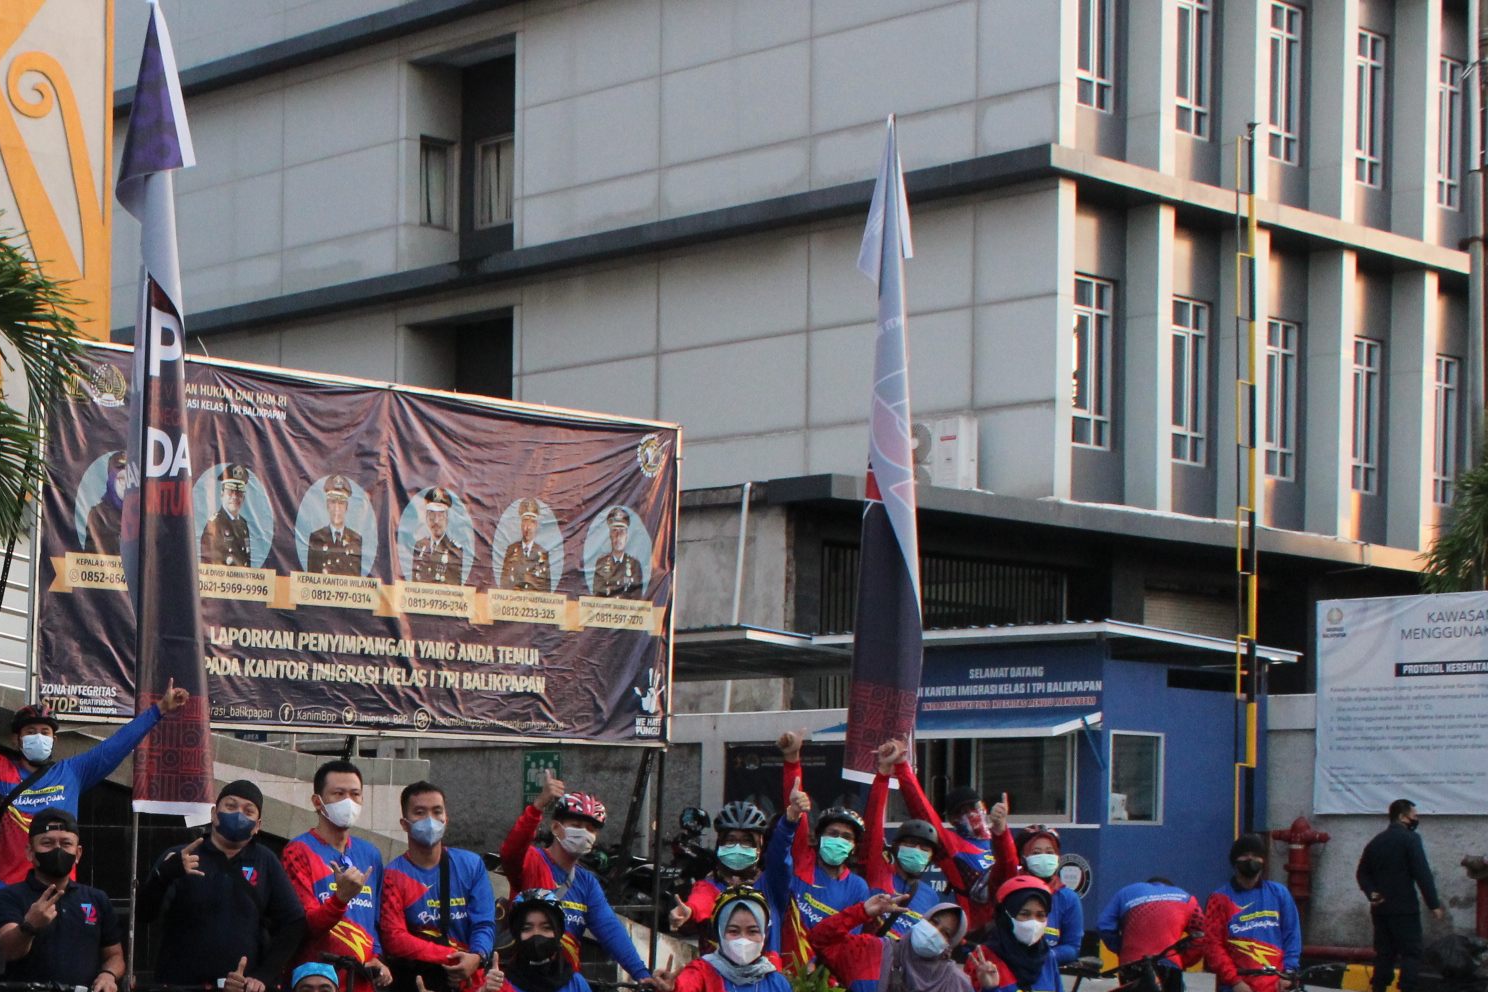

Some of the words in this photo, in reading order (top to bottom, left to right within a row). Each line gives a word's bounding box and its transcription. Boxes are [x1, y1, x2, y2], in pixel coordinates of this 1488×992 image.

[200, 384, 234, 400] HUKUM
[235, 389, 254, 402] DAN
[256, 392, 276, 406] HAM
[278, 395, 287, 407] RI
[186, 398, 200, 409] ASI
[201, 399, 224, 413] KELAS
[243, 406, 287, 421] BALIKPAPAN
[76, 558, 100, 567] KEPALA
[226, 571, 266, 581] ADMINISTRASI
[297, 575, 321, 584] KEPALA
[322, 577, 349, 587] KANTOR
[349, 579, 378, 589] WILAYAH
[311, 588, 371, 604] 0812-797-0314
[408, 597, 469, 612] 0813-9736-3346
[501, 605, 556, 620] 0812-2233-325
[1426, 609, 1488, 623] KAWASA
[210, 626, 295, 650] LAPORKAN
[297, 631, 415, 658] PENYIMPANGAN
[418, 640, 456, 661] YANG
[457, 643, 495, 663] ANDA
[497, 646, 540, 666] TEMUI
[244, 658, 309, 681] KANTOR
[312, 662, 380, 685] IMIGRASI
[383, 667, 428, 688] KELAS
[430, 670, 435, 687] I
[437, 670, 460, 689] TPI
[462, 672, 546, 694] BALIKPAPAN
[969, 667, 1009, 680] SELAMAT
[1403, 663, 1445, 675] PROTOKOL
[1446, 662, 1488, 673] KESEHATA
[41, 684, 67, 695] ZONA
[67, 684, 117, 697] INTEGRITAS
[924, 686, 957, 698] KANTOR
[958, 684, 998, 697] IMIGRASI
[998, 683, 1026, 695] KELAS
[1031, 682, 1046, 694] TPI
[1046, 680, 1103, 694] BALIKPAPAN
[42, 696, 78, 713] STOP
[79, 698, 114, 707] GRATIFIKASI
[209, 706, 273, 720] rasi_balikpapan
[296, 711, 337, 724] KanimBpp
[635, 717, 646, 727] WE
[80, 903, 99, 922] 72
